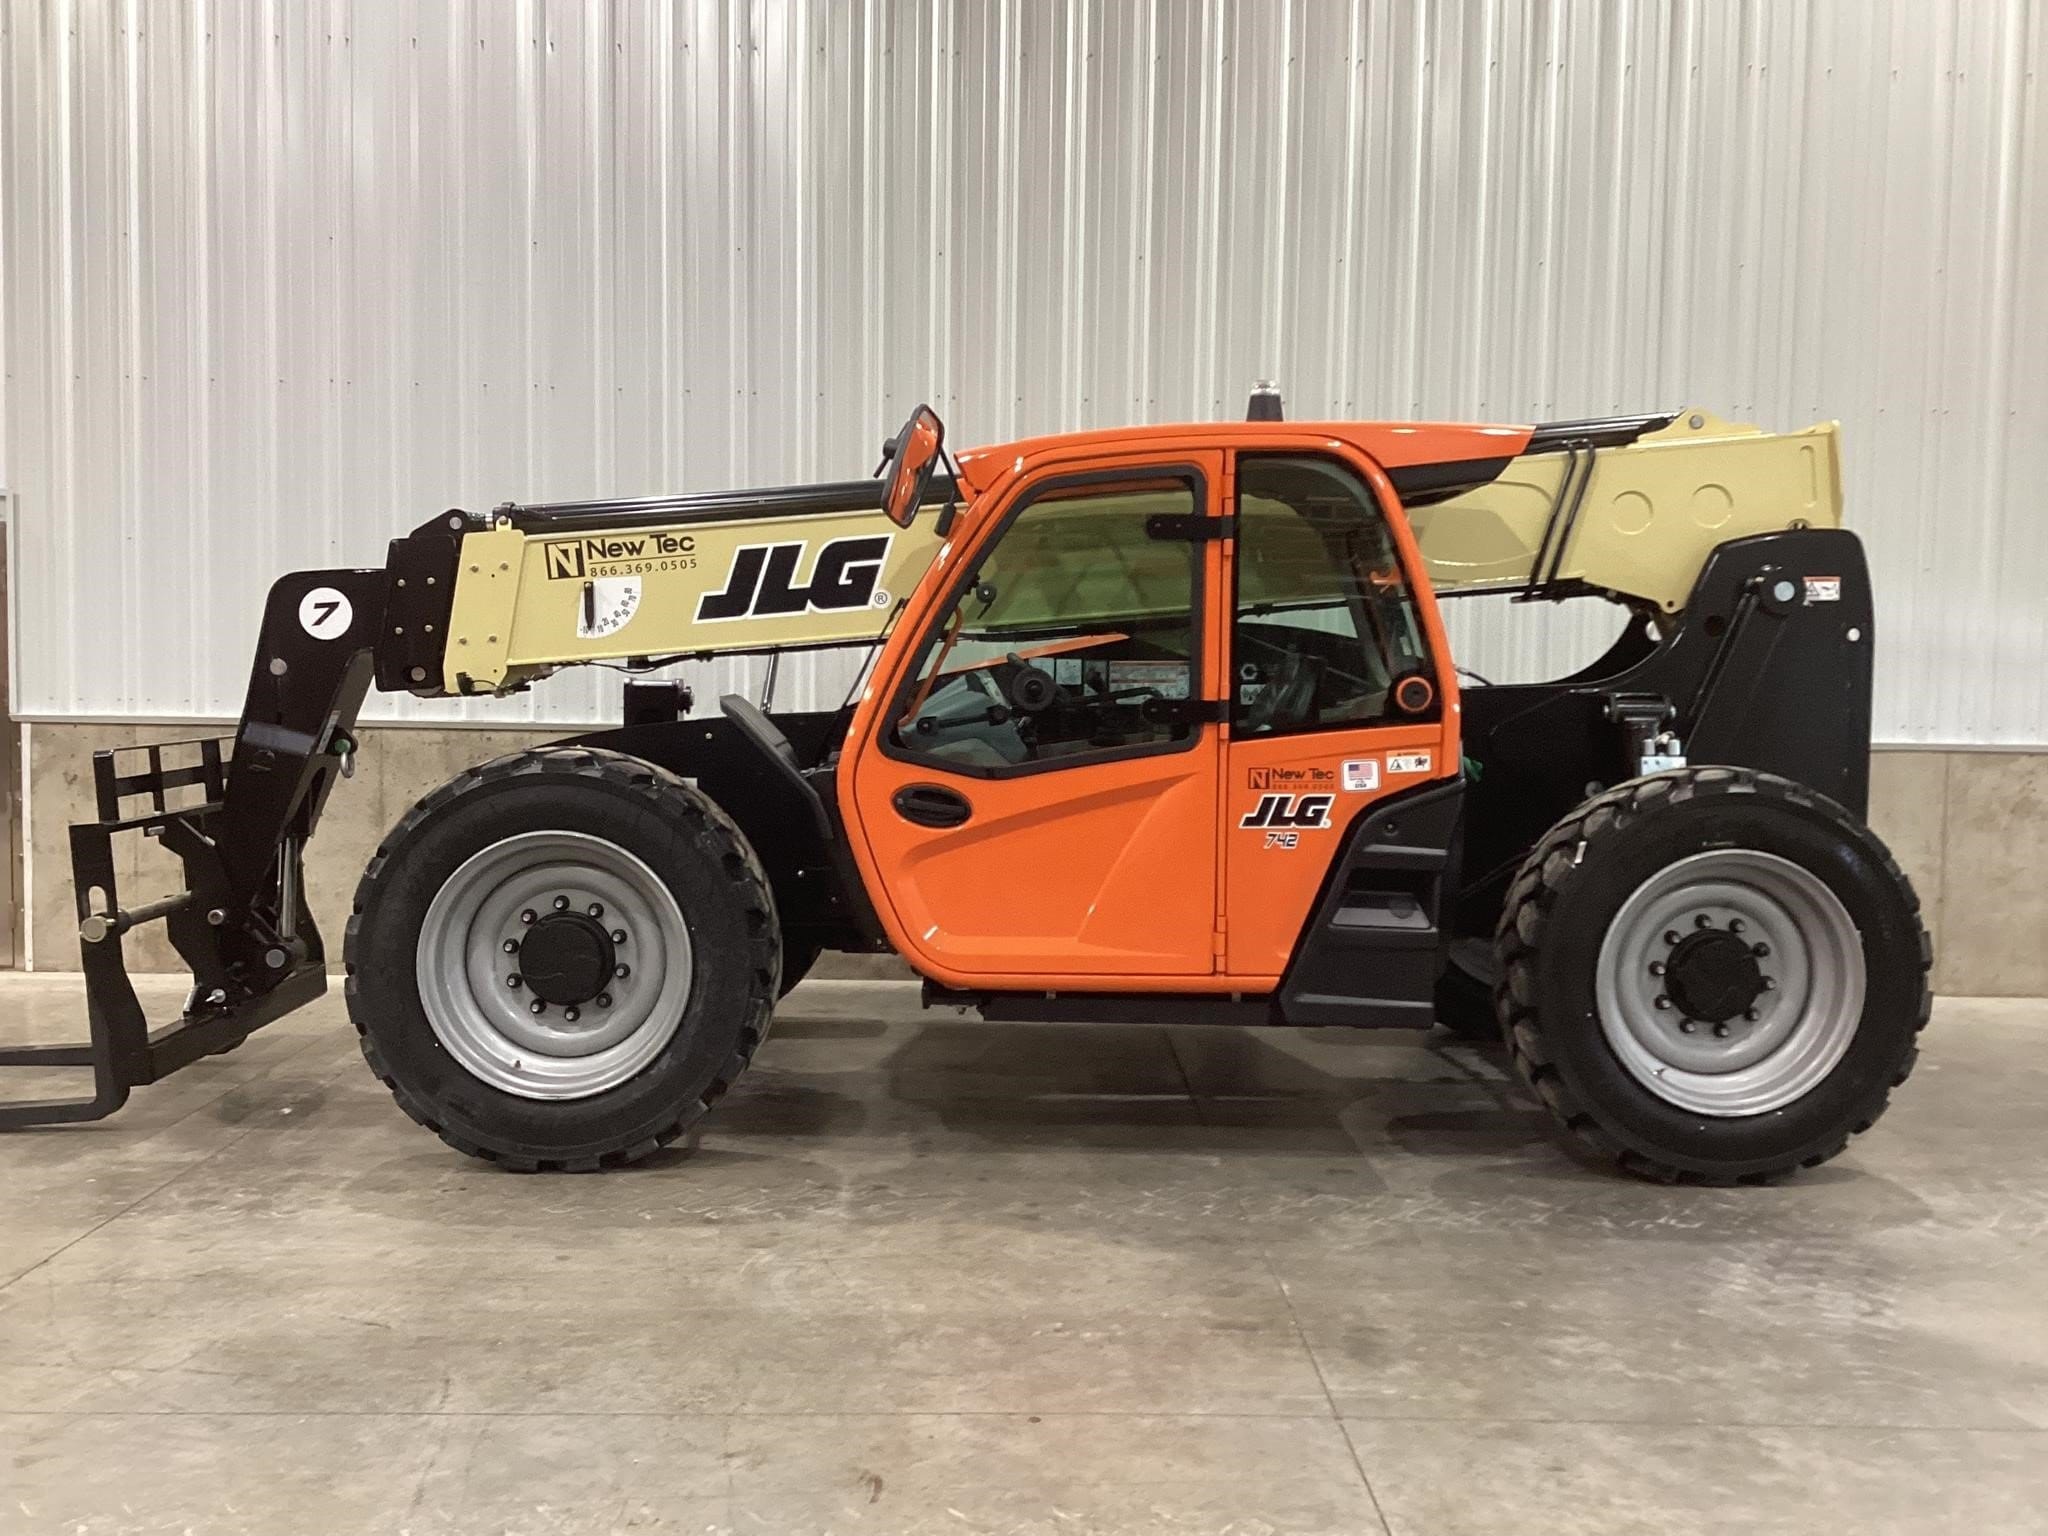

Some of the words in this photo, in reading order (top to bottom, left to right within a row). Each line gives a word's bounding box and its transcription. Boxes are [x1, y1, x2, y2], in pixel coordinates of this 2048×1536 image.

[586, 539, 646, 560] New
[649, 533, 695, 554] Tec
[590, 559, 697, 578] 866.369.0505
[695, 535, 891, 621] JLG
[311, 601, 341, 627] 7
[1272, 768, 1306, 780] New
[1309, 768, 1335, 780] Tec
[1241, 795, 1333, 827] JLG
[1265, 833, 1298, 848] 742
